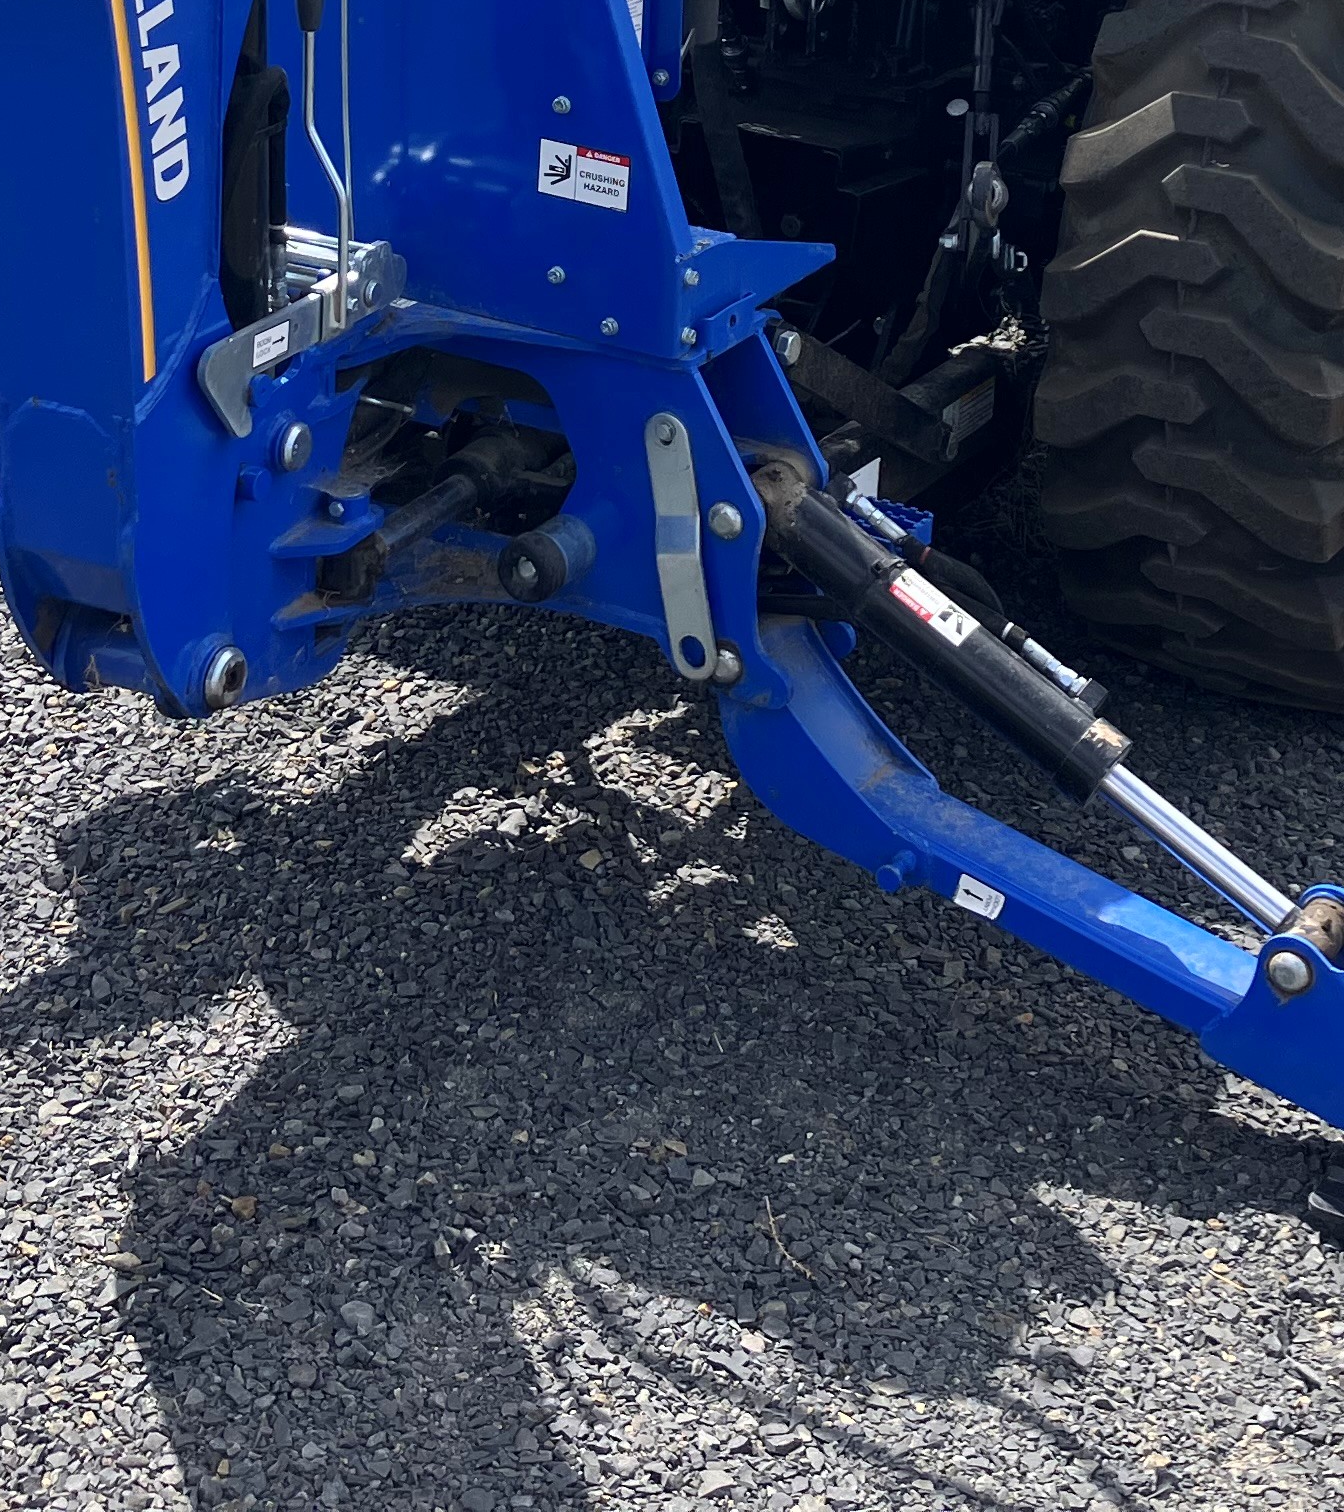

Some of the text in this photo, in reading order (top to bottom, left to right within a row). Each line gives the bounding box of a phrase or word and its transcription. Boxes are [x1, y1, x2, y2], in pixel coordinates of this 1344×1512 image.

[594, 152, 621, 164] DANGER
[579, 170, 626, 188] CRUSHING
[583, 182, 620, 197] HAZARD
